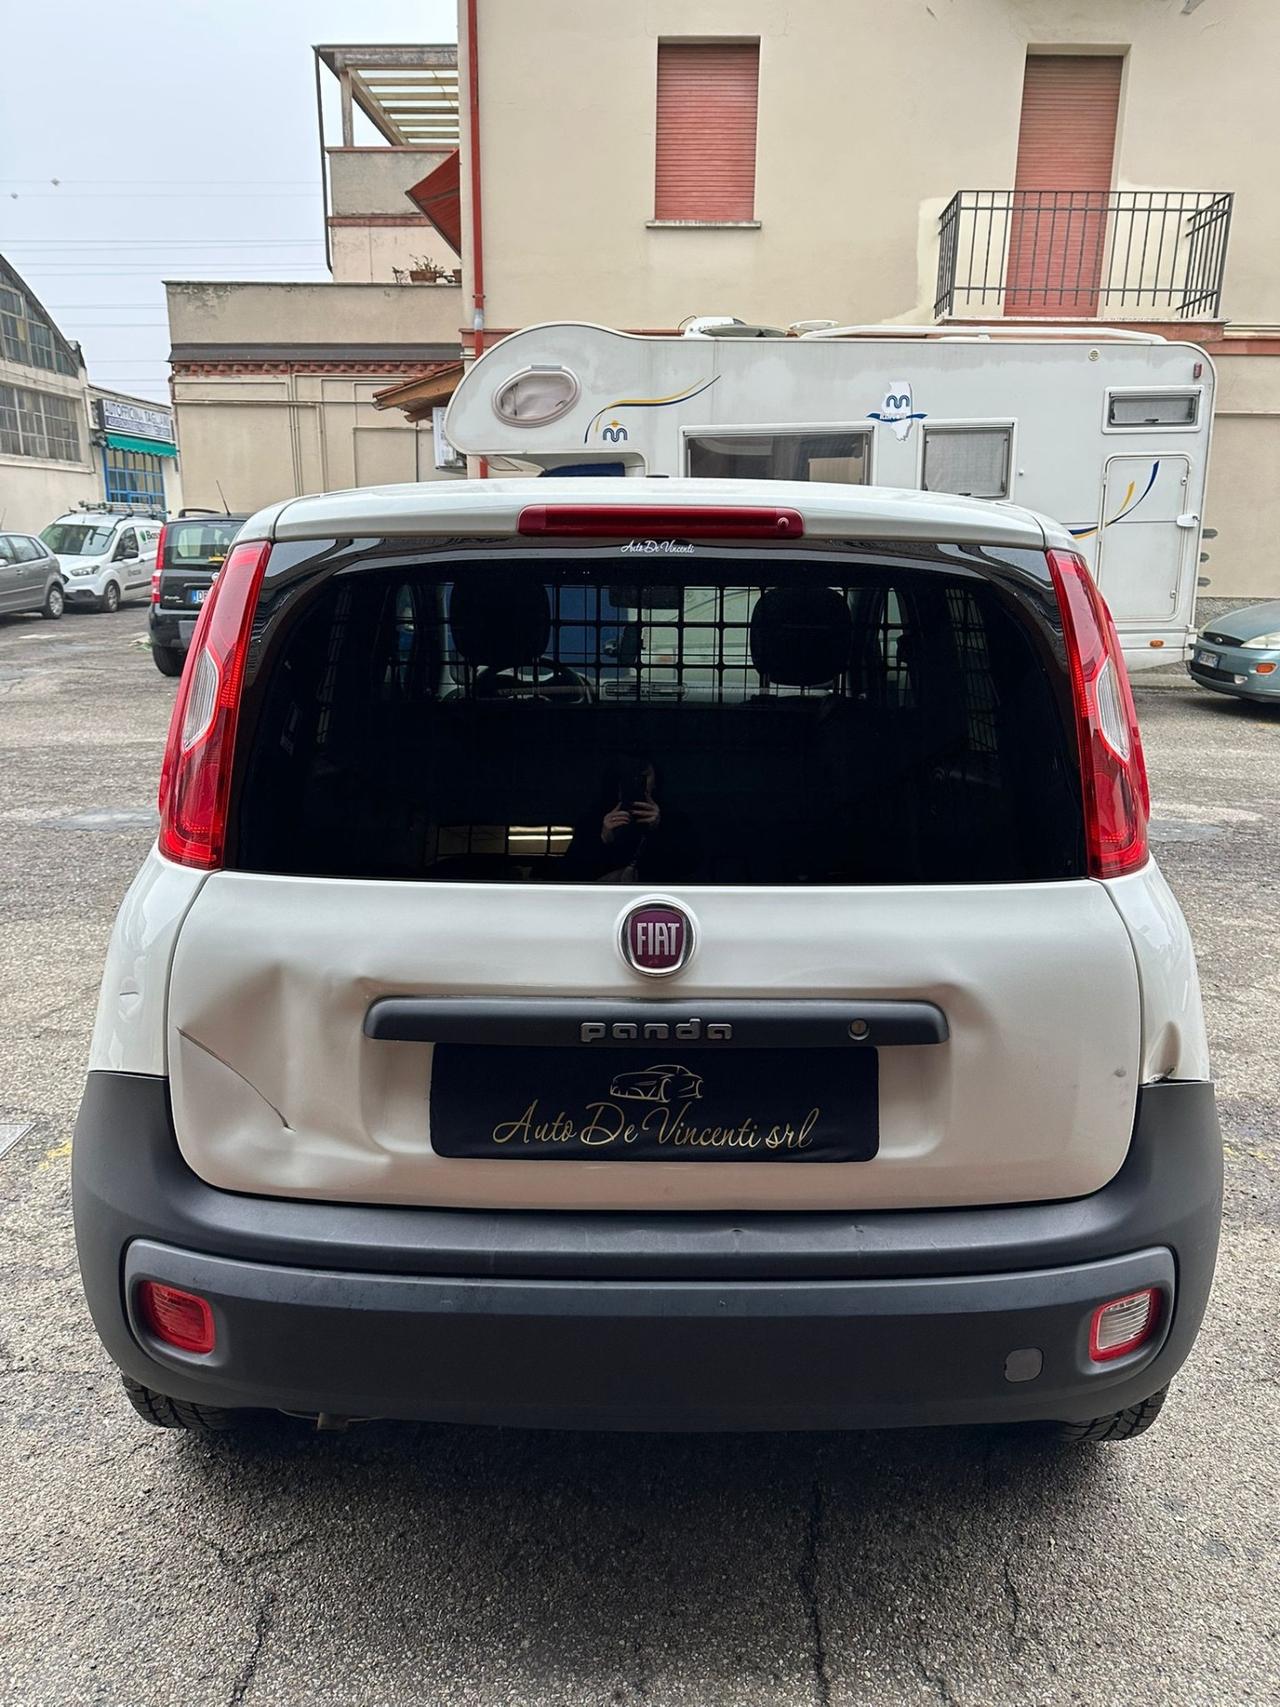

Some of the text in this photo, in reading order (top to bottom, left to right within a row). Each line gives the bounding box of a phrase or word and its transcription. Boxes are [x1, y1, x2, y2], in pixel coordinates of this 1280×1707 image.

[620, 539, 695, 553] Auto De Vincenti
[636, 922, 680, 956] FIAT
[580, 1018, 733, 1043] panda
[492, 1099, 820, 1149] Auto De Vincenti srl
